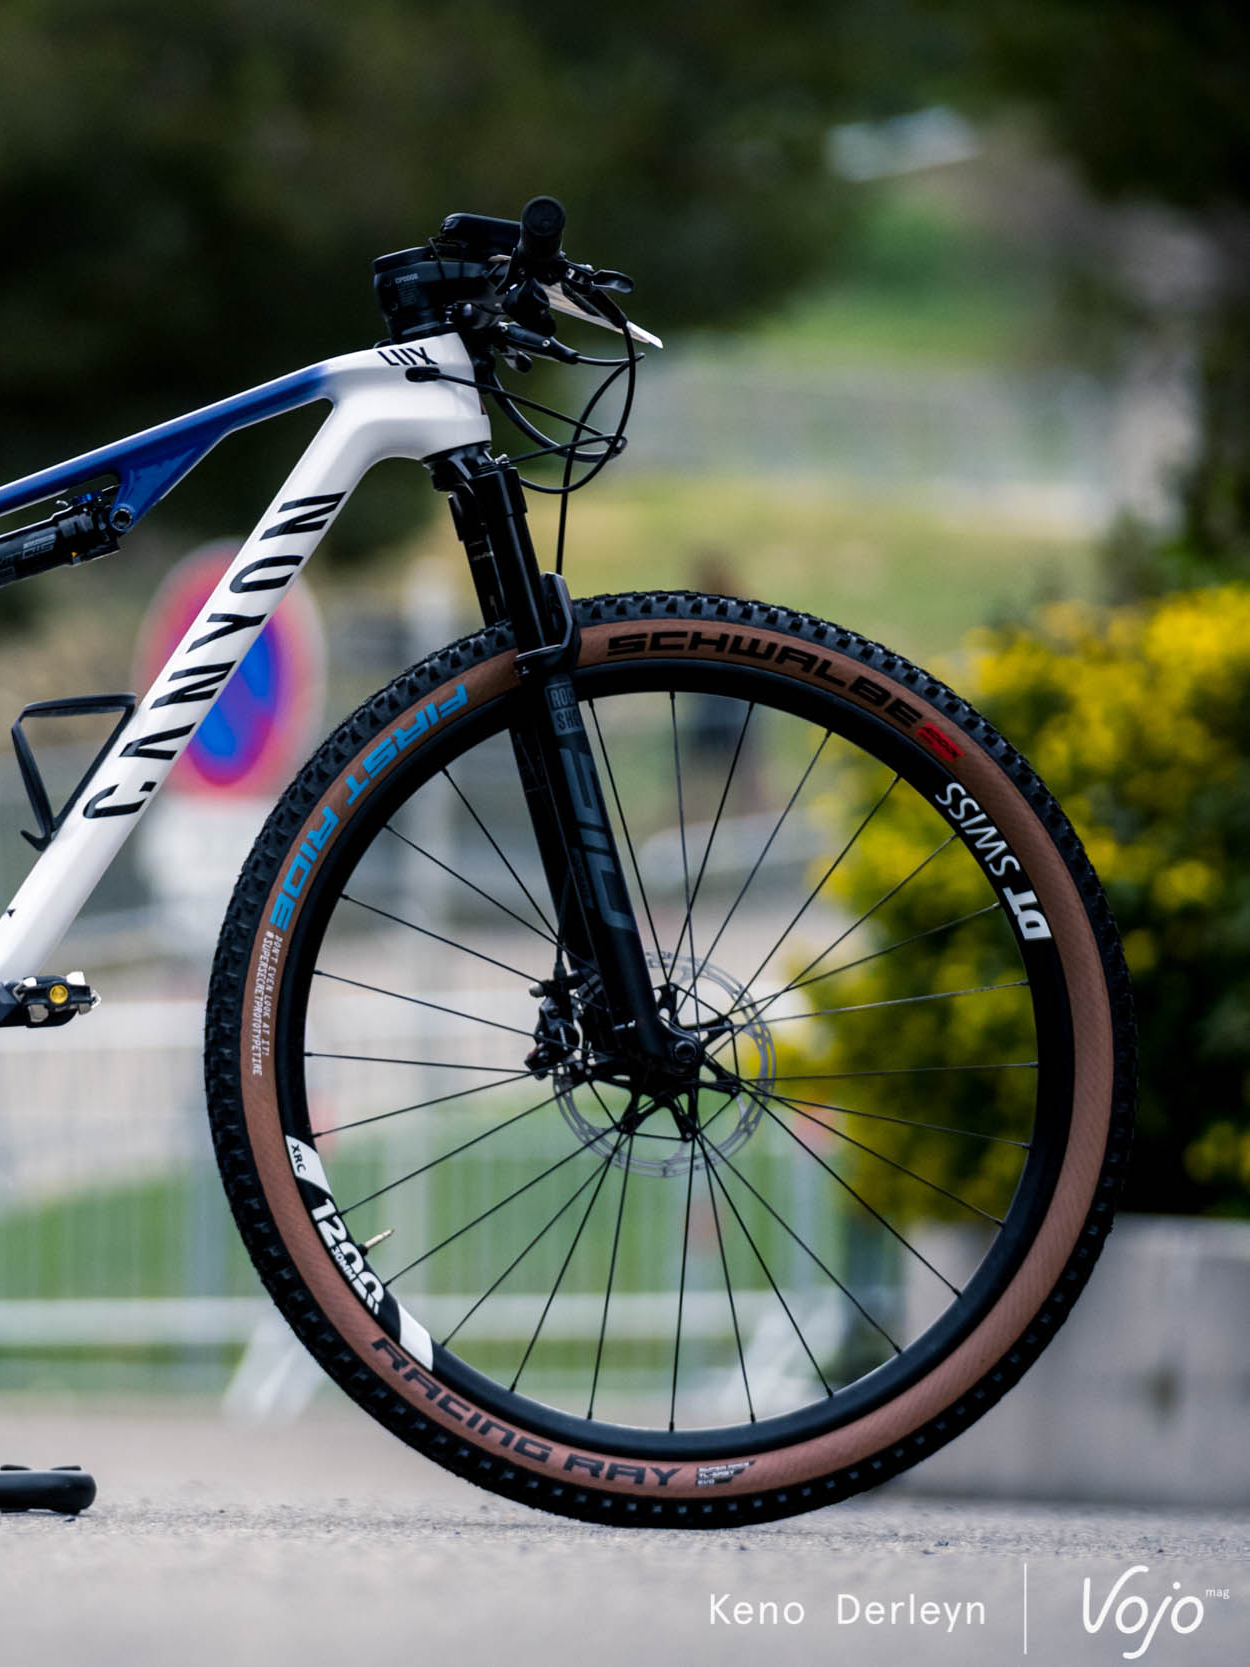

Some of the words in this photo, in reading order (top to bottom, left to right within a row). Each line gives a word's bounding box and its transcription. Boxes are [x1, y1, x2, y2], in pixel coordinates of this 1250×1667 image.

[376, 346, 439, 366] LUX
[607, 631, 923, 728] SCHWALBE
[345, 683, 469, 806] FIRST
[270, 805, 340, 932] RIDE
[935, 782, 1021, 877] SWISS
[1002, 886, 1053, 941] DT
[262, 994, 273, 1020] LOOK
[265, 965, 277, 993] EVEN
[290, 1143, 307, 1173] XRC
[311, 1198, 385, 1316] 1200
[371, 1337, 552, 1463] RACING
[562, 1453, 682, 1487] RAY
